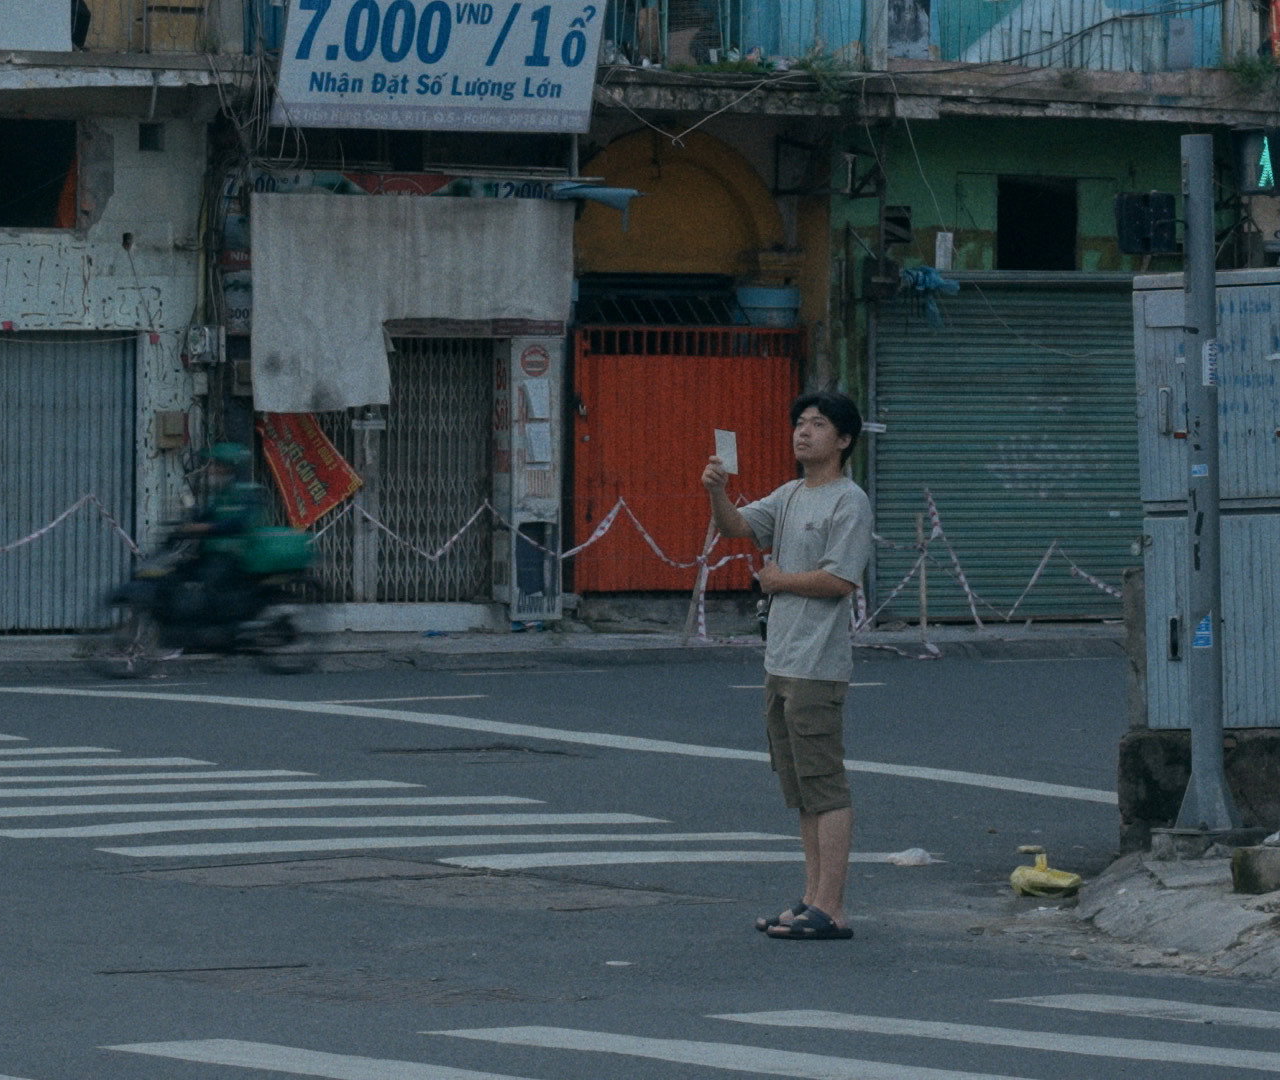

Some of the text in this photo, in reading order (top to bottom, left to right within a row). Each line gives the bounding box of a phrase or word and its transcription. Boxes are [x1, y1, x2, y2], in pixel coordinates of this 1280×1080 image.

[456, 2, 493, 25] VND
[308, 71, 562, 101] Nhận Đặt Số Lượng Lớn
